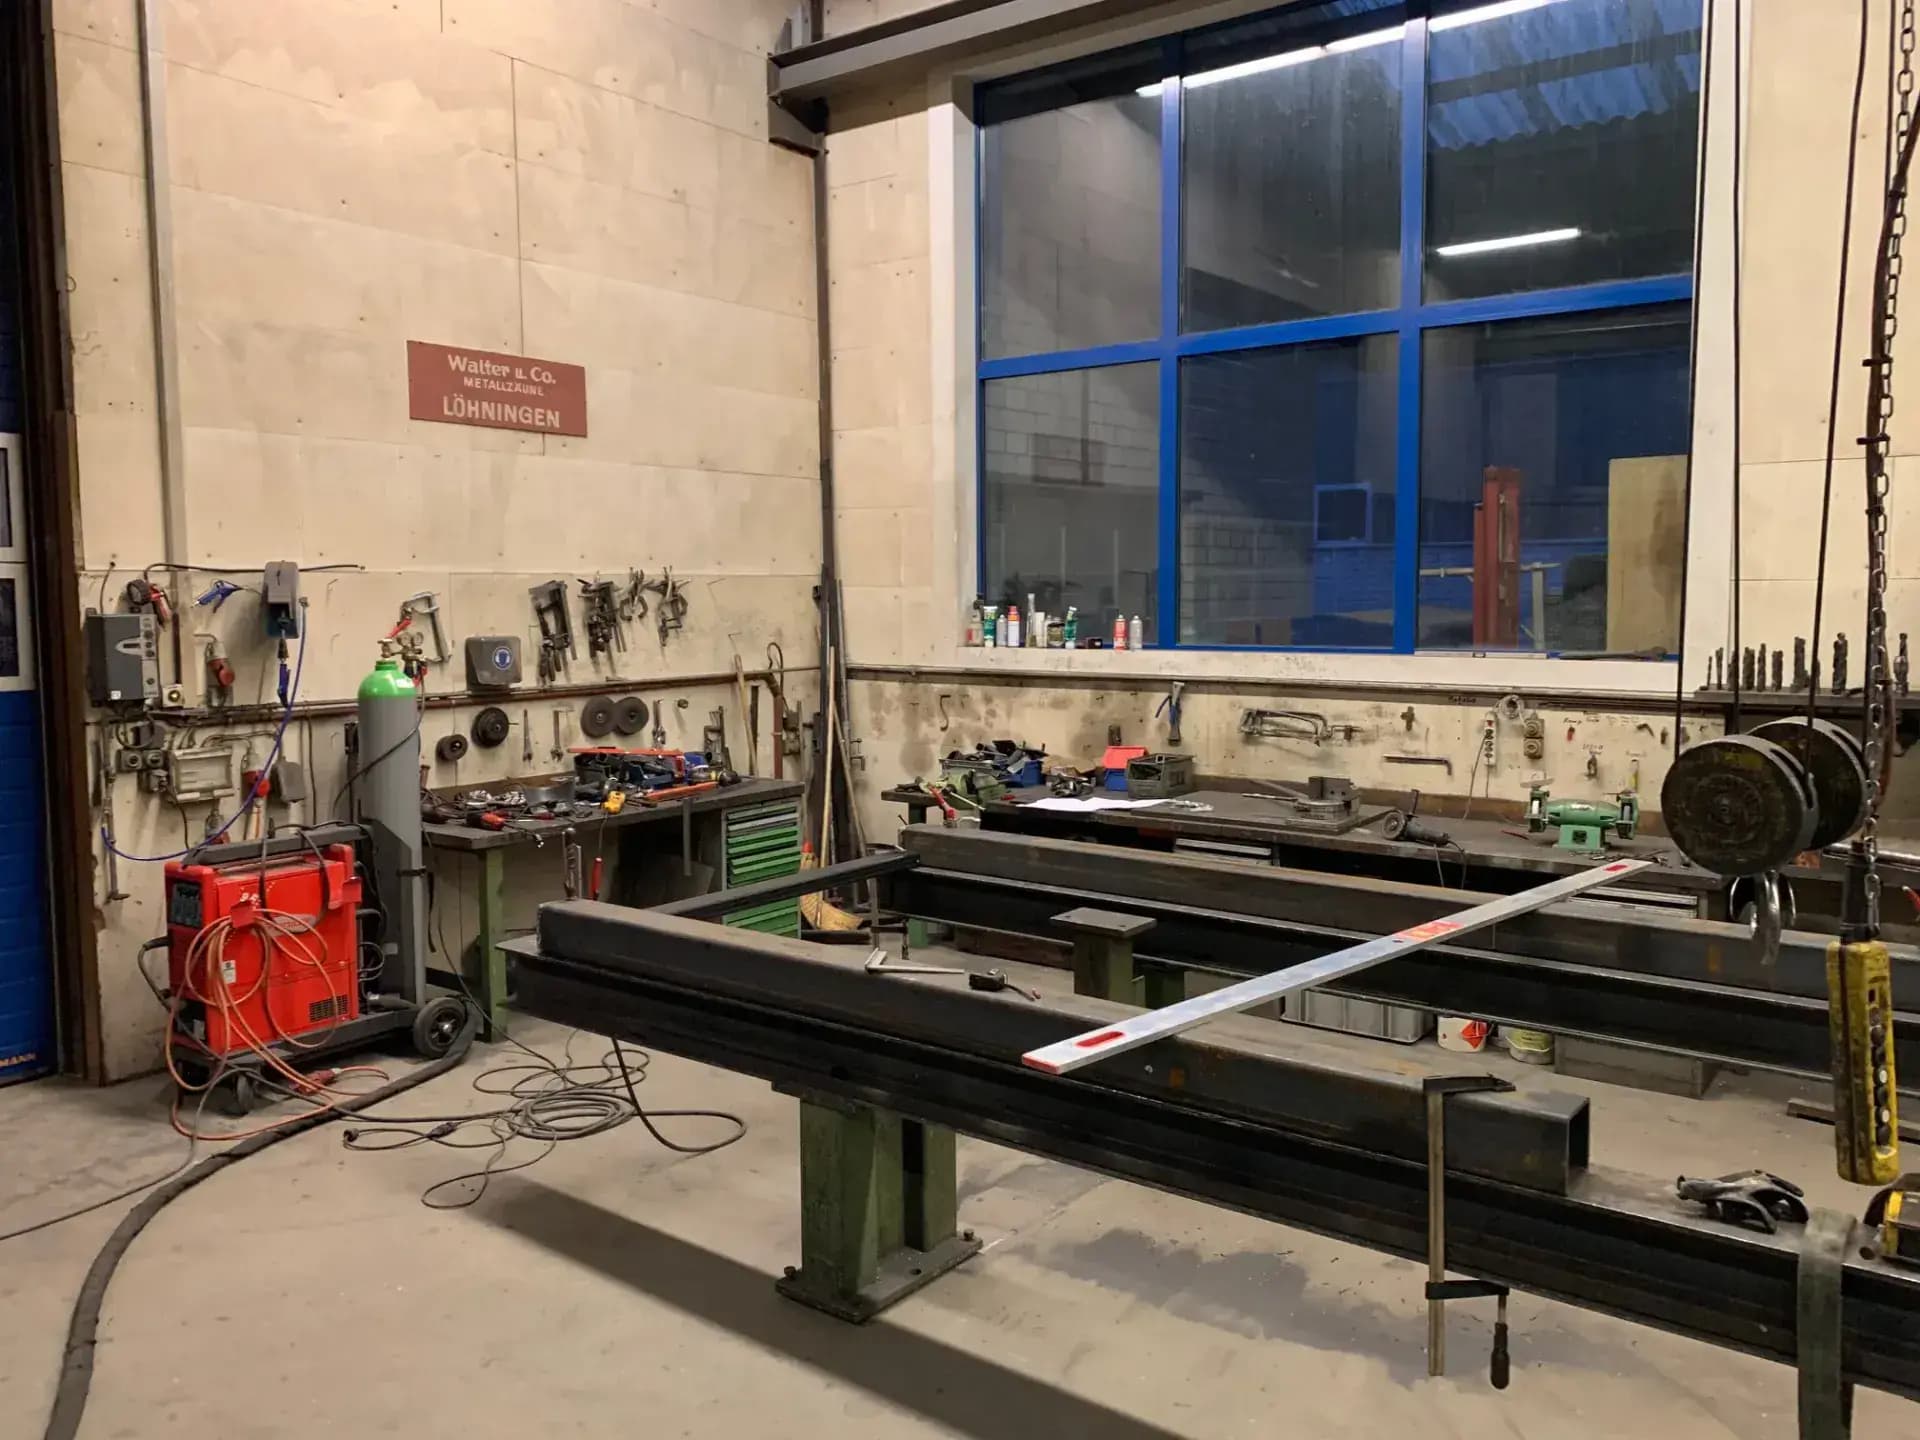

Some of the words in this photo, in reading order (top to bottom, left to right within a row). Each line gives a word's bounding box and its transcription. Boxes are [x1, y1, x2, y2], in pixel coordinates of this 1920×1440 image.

[448, 354, 510, 377] Walter
[530, 367, 557, 384] Co.
[443, 394, 560, 428] LÖHNINGEN
